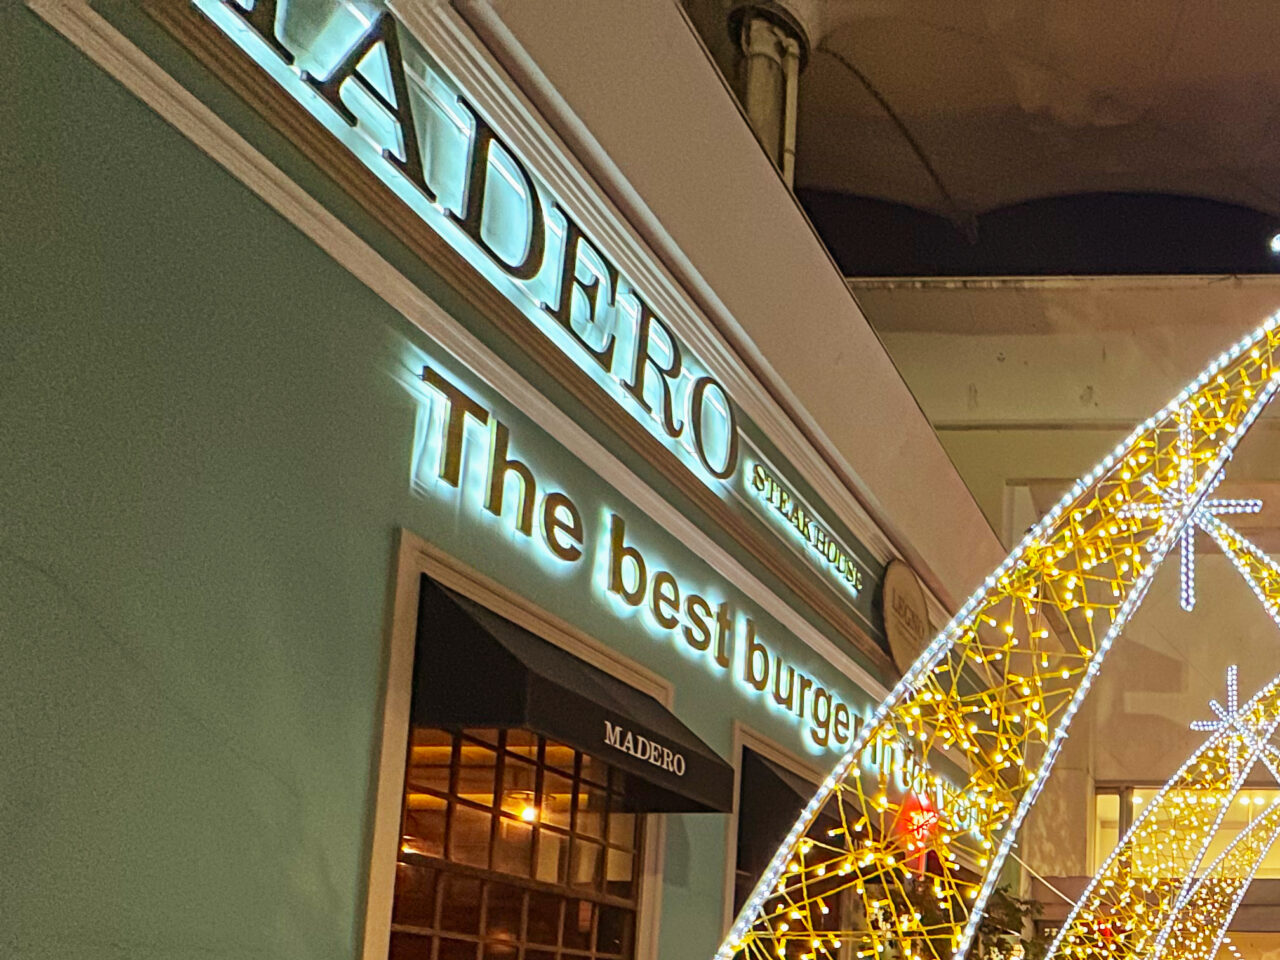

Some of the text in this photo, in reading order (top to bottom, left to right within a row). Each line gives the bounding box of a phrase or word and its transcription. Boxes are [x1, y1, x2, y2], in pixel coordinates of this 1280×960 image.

[752, 463, 814, 543] STEAK
[422, 365, 583, 562] The
[608, 513, 732, 669] best
[744, 618, 864, 747] burger
[604, 720, 686, 777] MADERO
